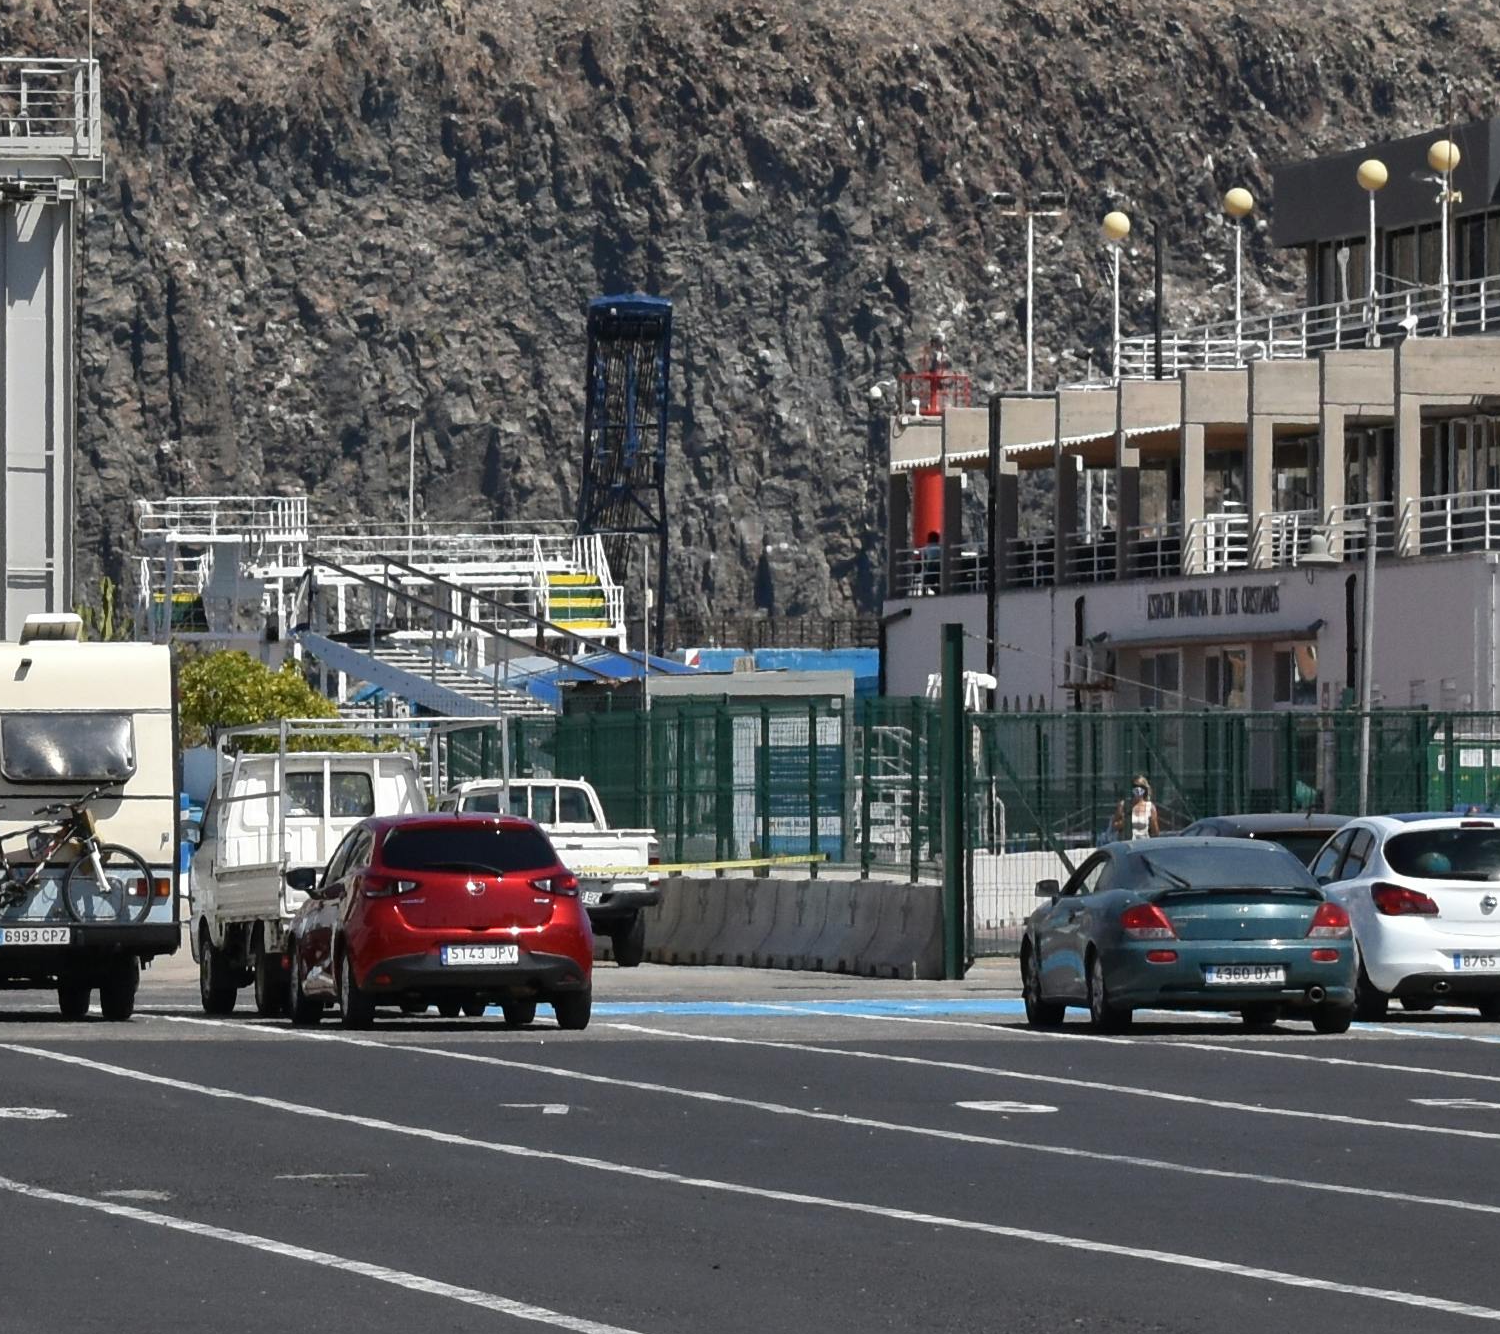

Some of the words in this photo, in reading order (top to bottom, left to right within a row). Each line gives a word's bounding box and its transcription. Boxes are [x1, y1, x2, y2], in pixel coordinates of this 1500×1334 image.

[5, 930, 38, 943] 6993
[42, 929, 67, 942] CPZ
[452, 947, 484, 959] 5143
[491, 947, 514, 959] JPV
[1464, 955, 1496, 967] 8765
[1216, 967, 1250, 980] 4360
